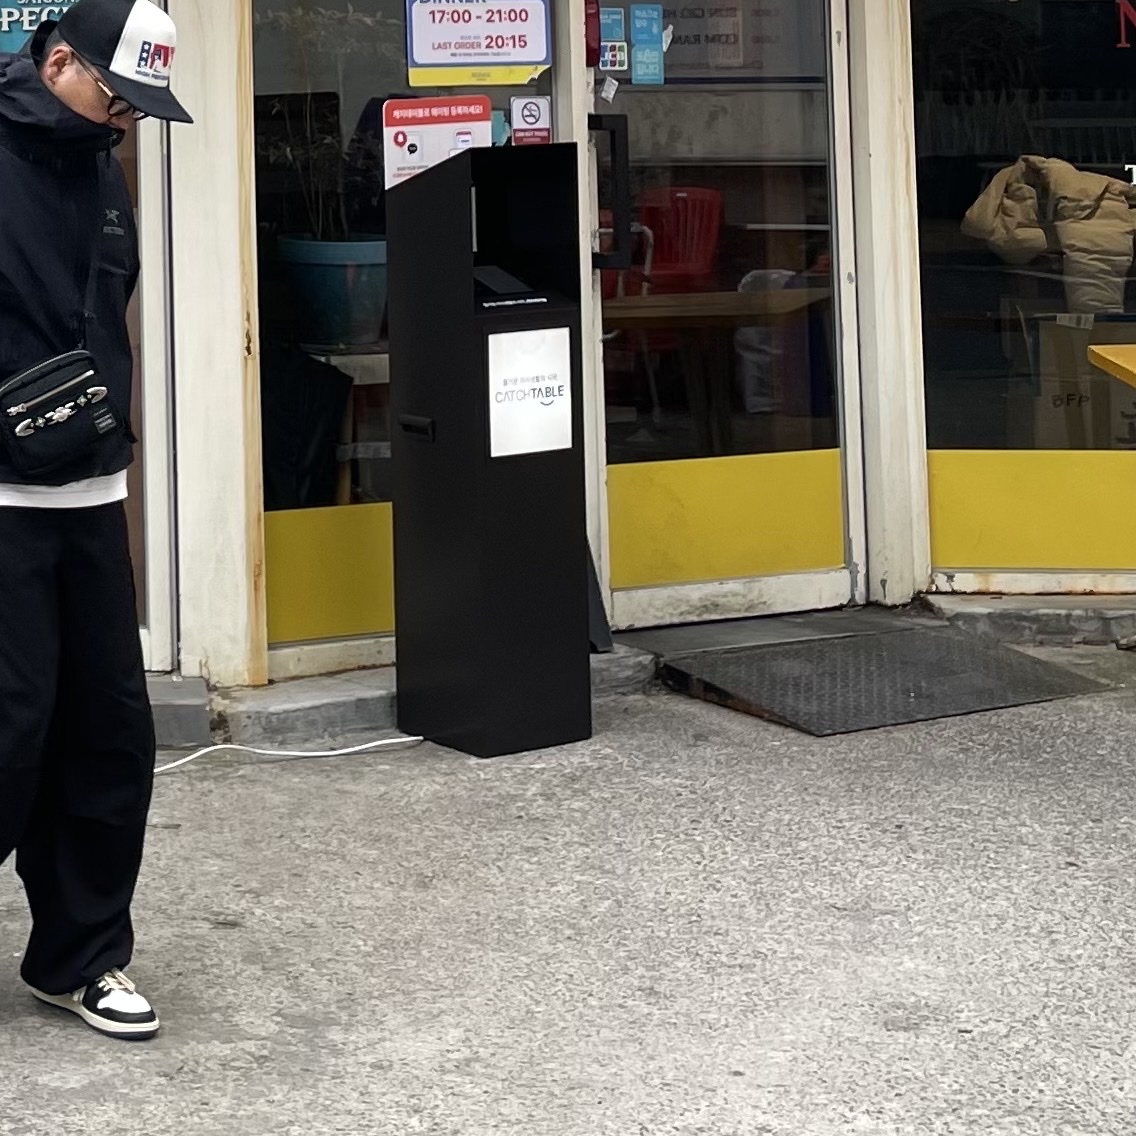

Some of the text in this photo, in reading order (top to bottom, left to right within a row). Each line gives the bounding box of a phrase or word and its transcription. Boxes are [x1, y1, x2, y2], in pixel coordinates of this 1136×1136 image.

[429, 9, 472, 24] 17:00
[485, 8, 529, 23] 21:00
[432, 41, 452, 50] LAST
[454, 41, 482, 50] ORDER
[484, 34, 528, 49] 20:15
